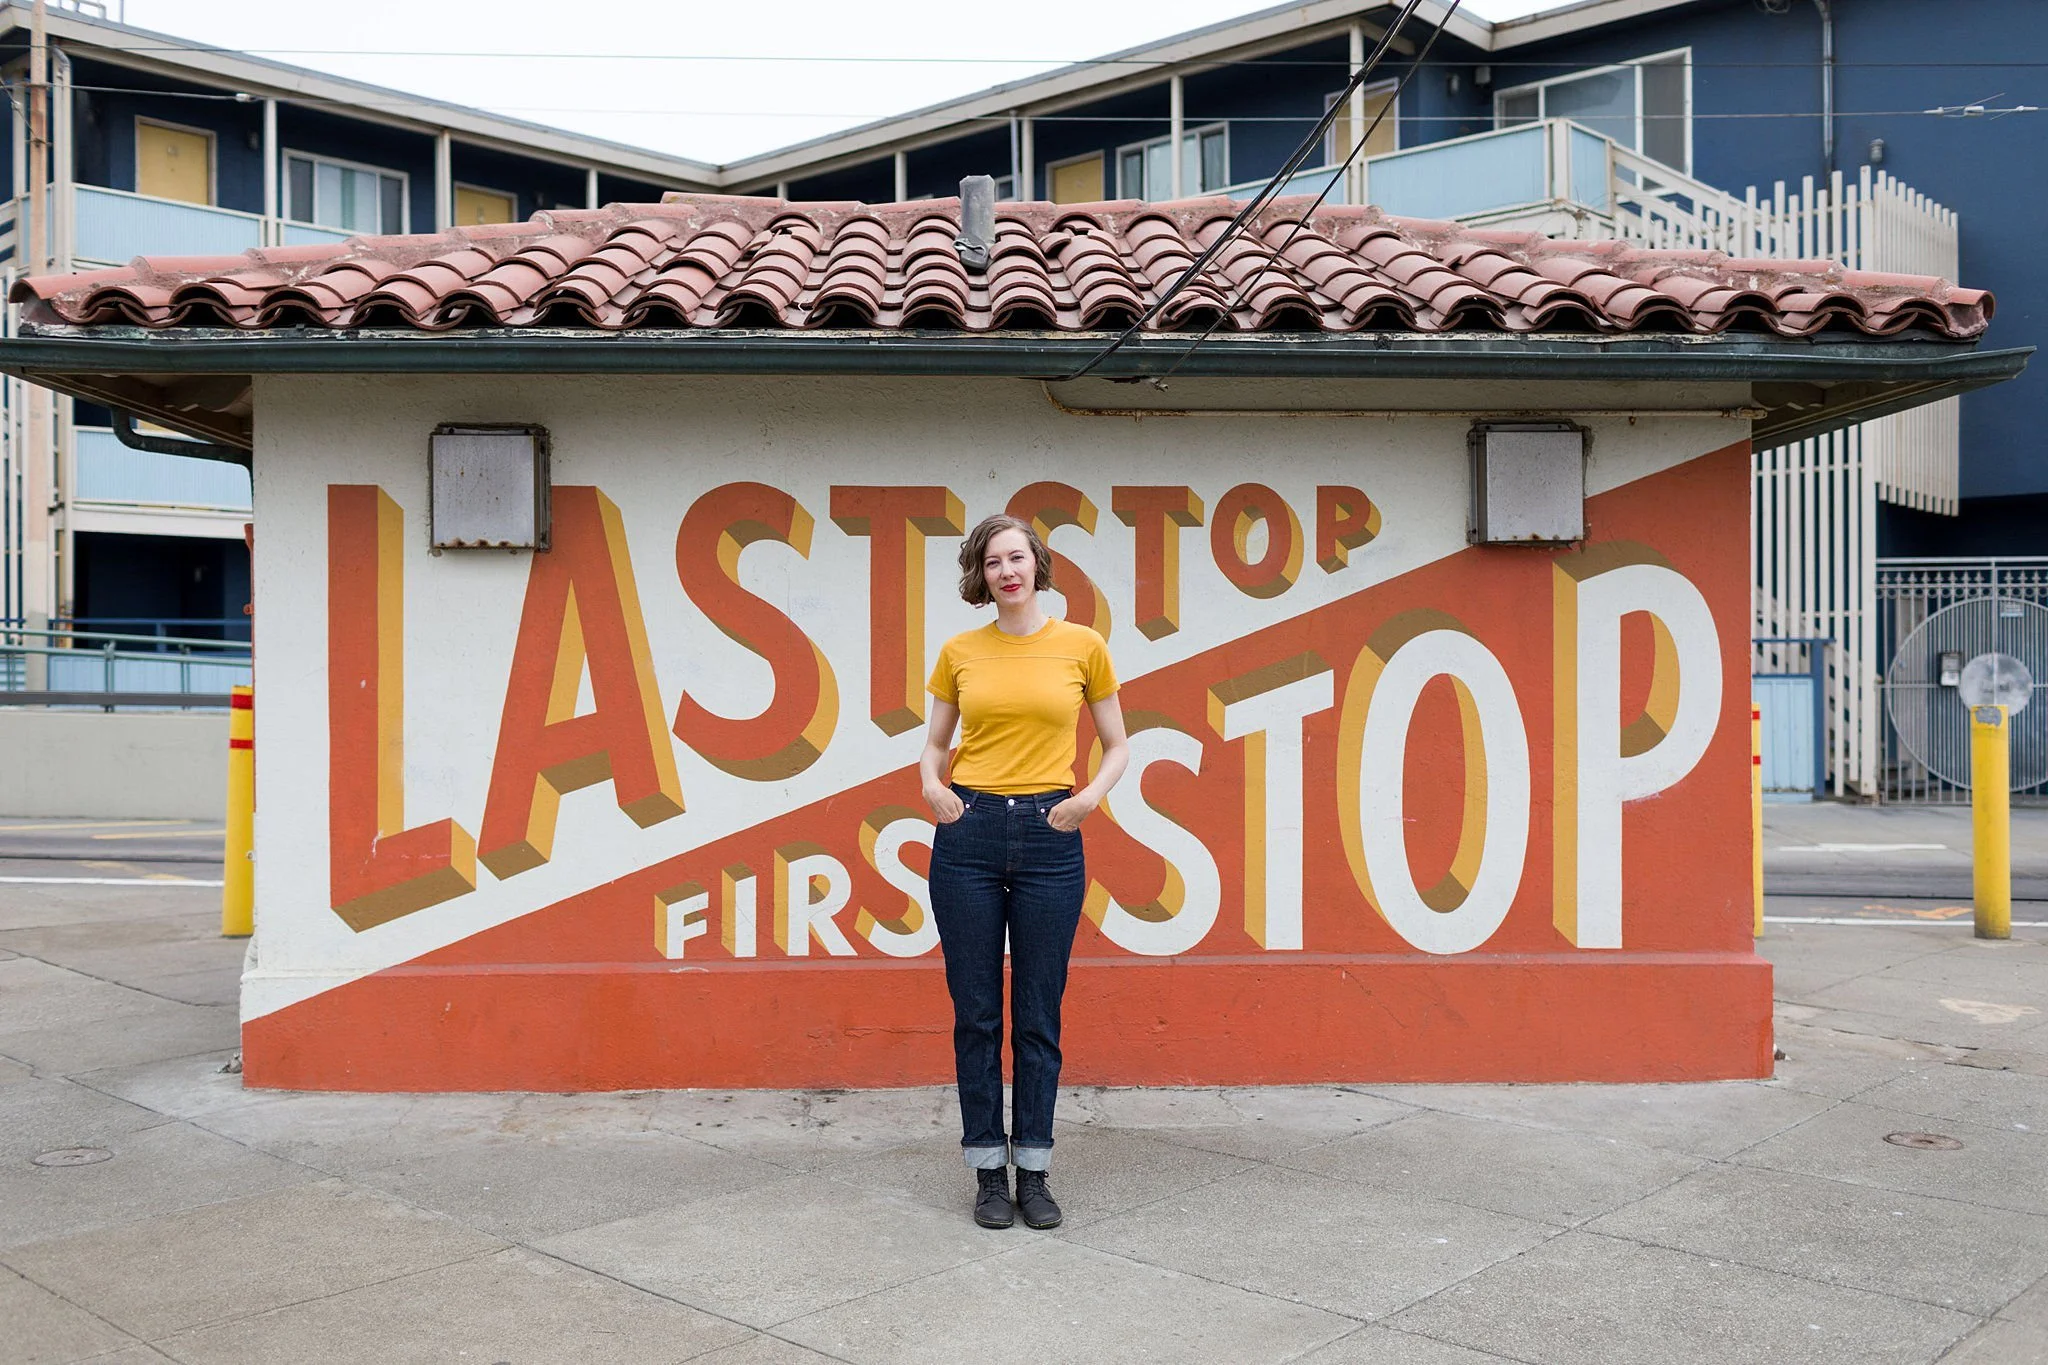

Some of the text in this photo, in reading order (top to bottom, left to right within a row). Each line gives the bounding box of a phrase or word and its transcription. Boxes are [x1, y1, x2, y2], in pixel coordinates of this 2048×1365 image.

[328, 481, 1381, 933] LAST STOP
[654, 541, 1722, 957] FIRS STOP
